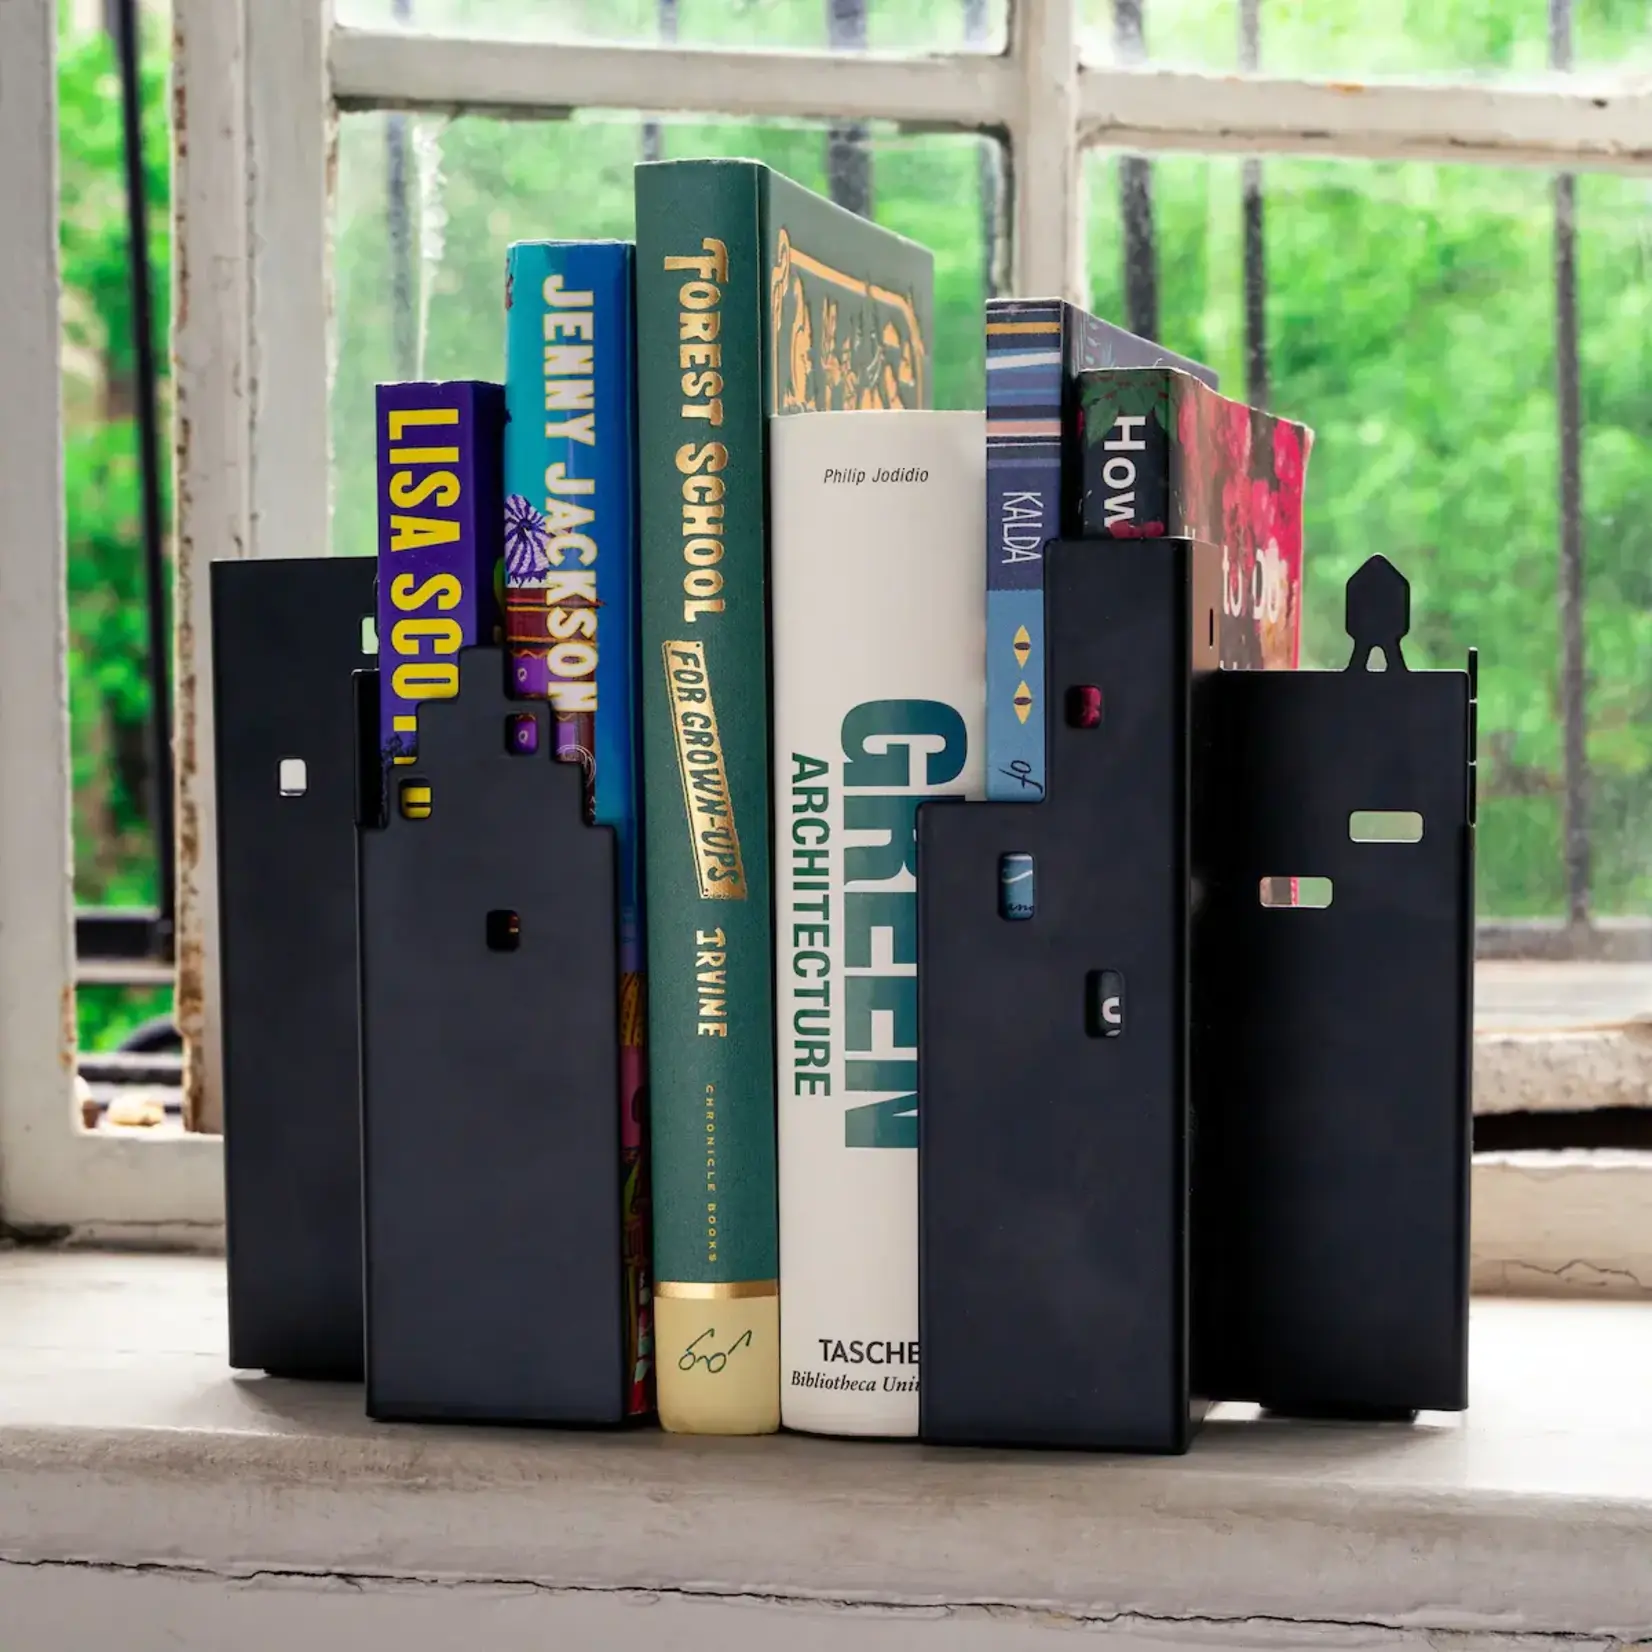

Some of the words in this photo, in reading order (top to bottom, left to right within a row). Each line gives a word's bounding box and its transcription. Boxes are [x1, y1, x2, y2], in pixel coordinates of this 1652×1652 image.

[543, 274, 595, 446] JENNY
[664, 238, 729, 427] FOREST
[388, 408, 462, 552] LISA
[824, 468, 866, 486] Philip
[872, 468, 929, 484] Jodidio
[1001, 492, 1043, 565] KALDA
[1103, 416, 1147, 531] How
[544, 462, 598, 712] JACKSON
[675, 442, 728, 622] SCHOOL
[671, 650, 707, 704] FOR
[681, 711, 740, 886] GROWN-UPS
[999, 759, 1044, 794] of
[791, 752, 831, 1097] ARCHITECTURE
[841, 698, 968, 1149] GREEN
[695, 926, 728, 1037] IRVINE
[704, 1083, 717, 1192] CHRONICLE
[707, 1202, 718, 1263] BOOKS
[791, 1370, 877, 1392] Bibliotheca
